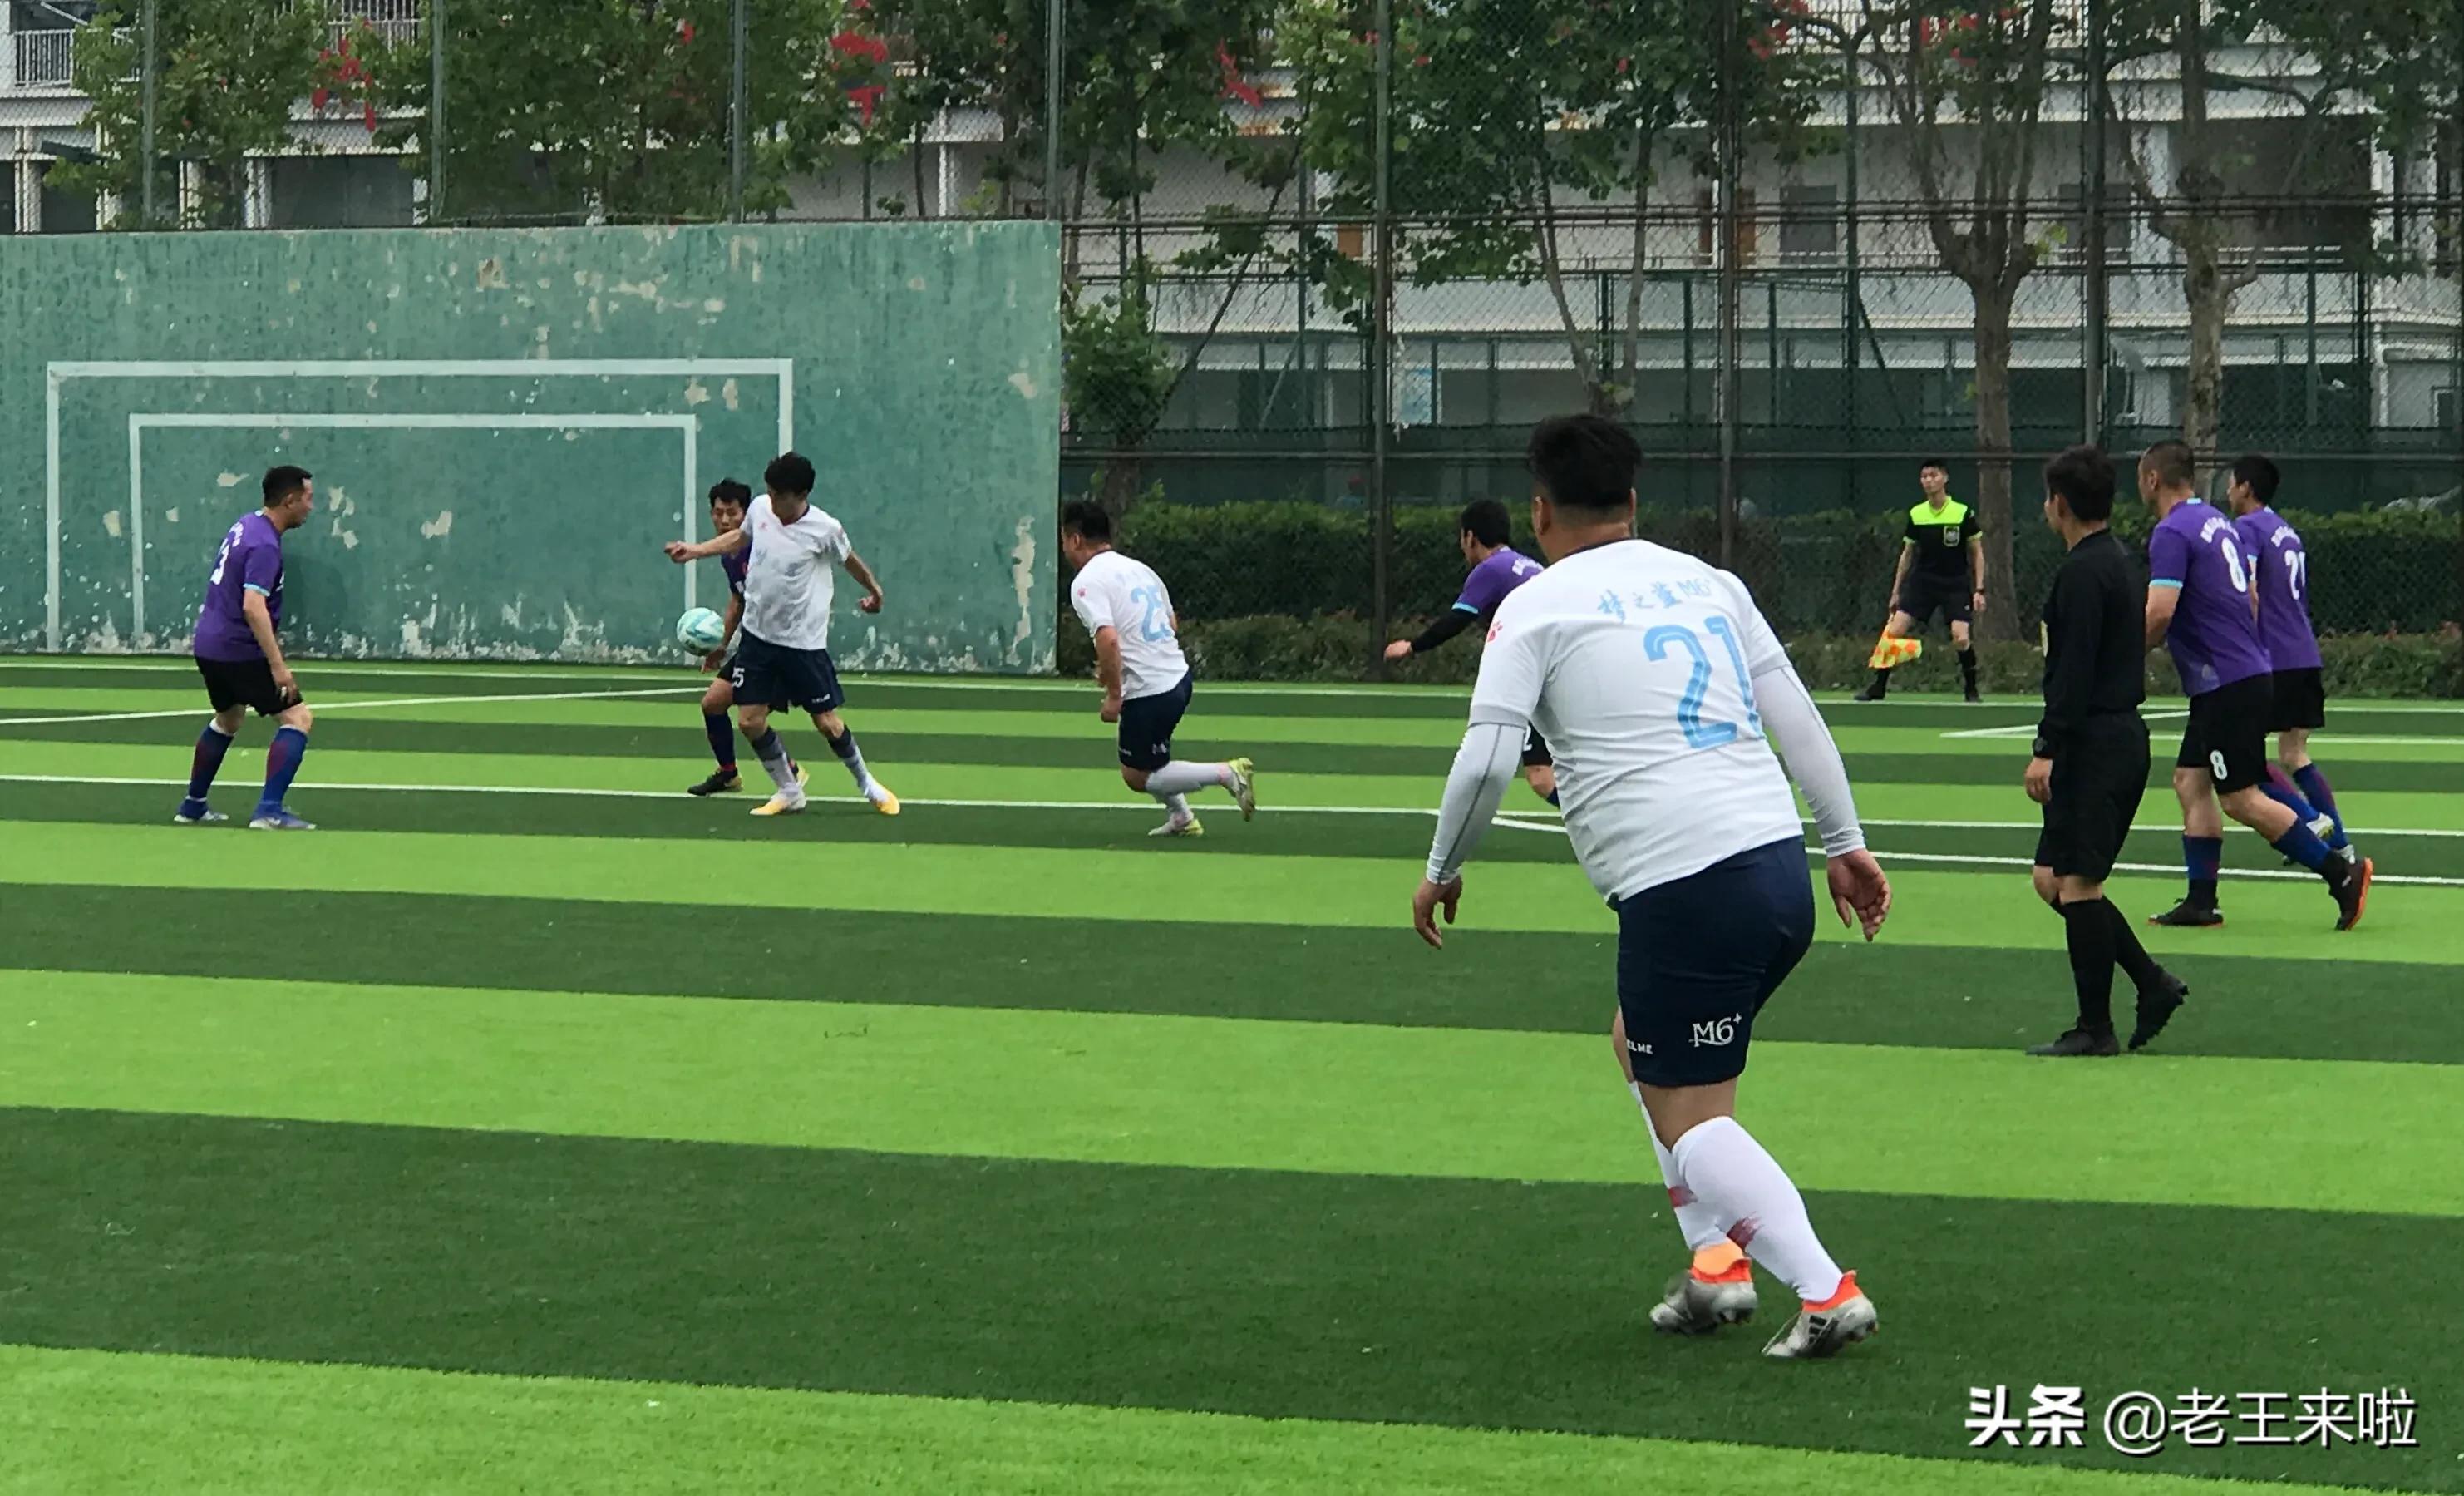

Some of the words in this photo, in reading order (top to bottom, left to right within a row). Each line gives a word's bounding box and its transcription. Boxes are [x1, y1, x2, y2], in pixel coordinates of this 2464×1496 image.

[2221, 536, 2247, 593] 8
[1643, 615, 1767, 748] 21
[2210, 749, 2228, 780] 8
